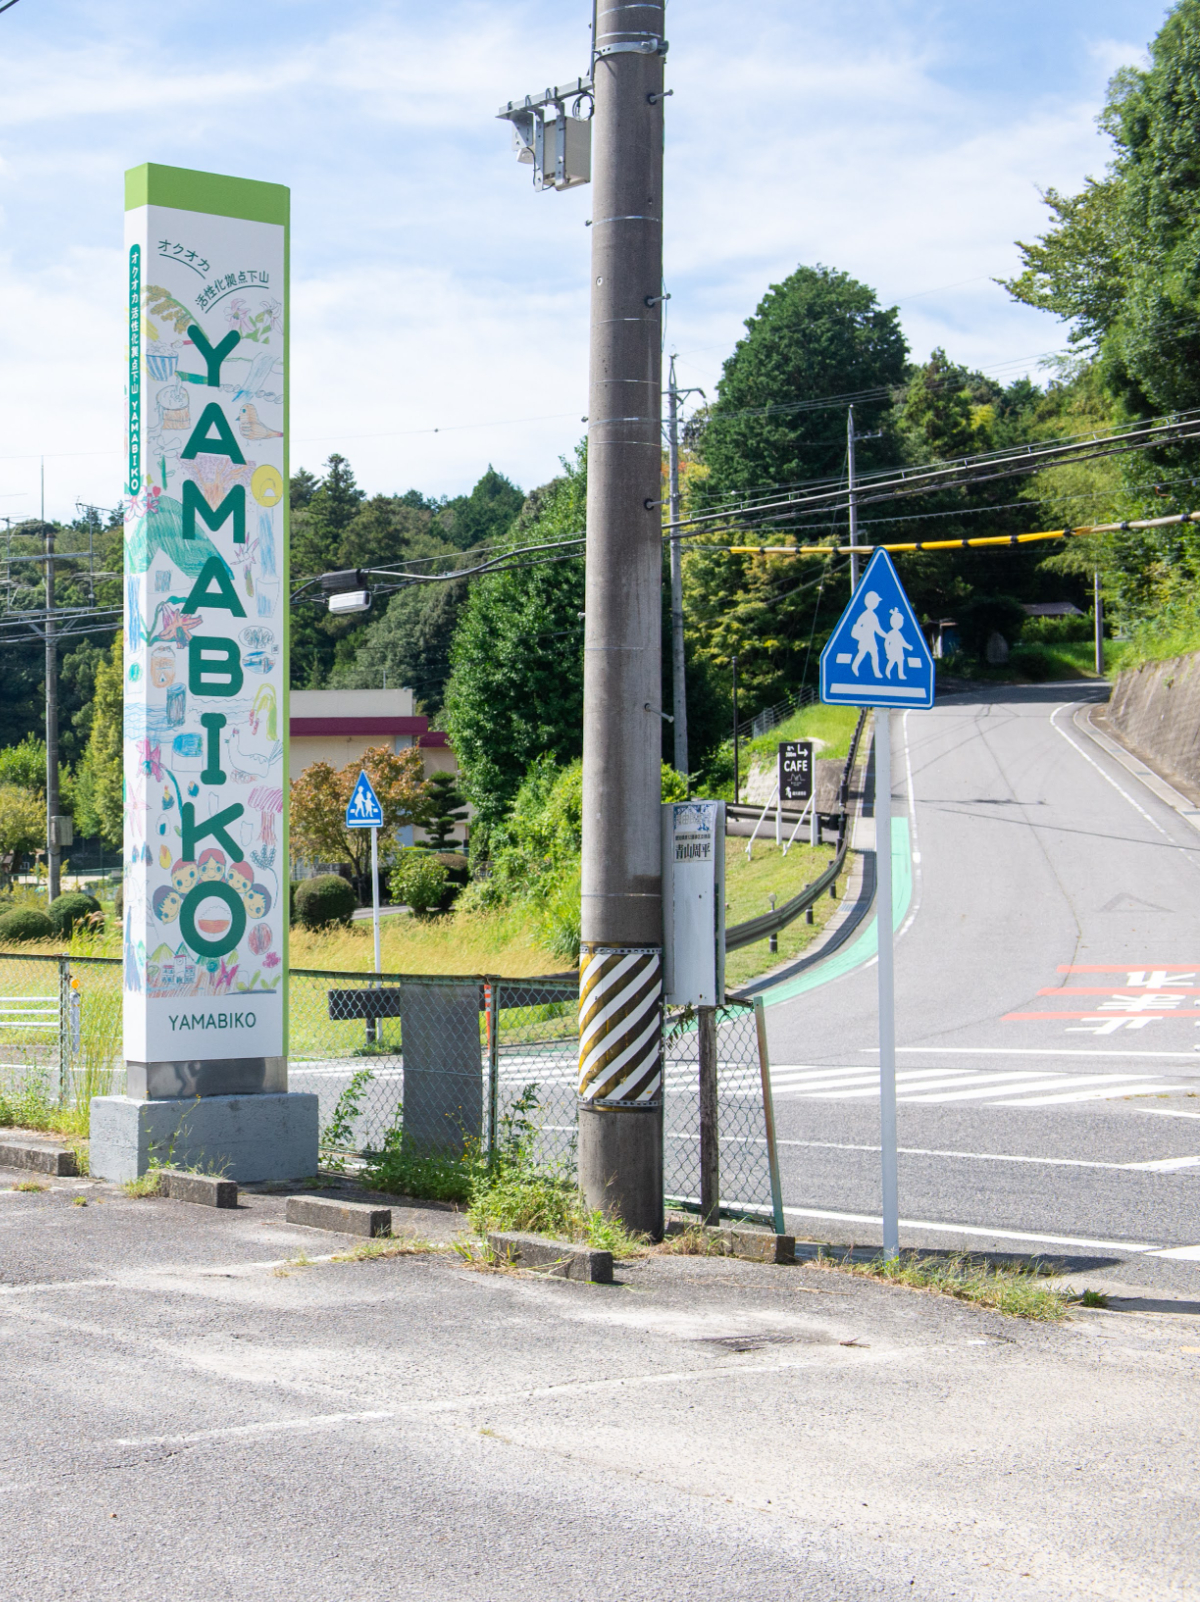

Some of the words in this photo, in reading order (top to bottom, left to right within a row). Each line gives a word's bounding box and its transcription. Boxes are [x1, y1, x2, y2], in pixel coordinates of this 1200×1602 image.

[157, 239, 211, 272] オクオカ
[130, 401, 139, 489] YAMABIKO
[178, 324, 248, 958] YAMABIKO
[783, 760, 808, 772] CAFE
[675, 842, 711, 860] 青山周平
[168, 1012, 257, 1032] YAMABIKO
